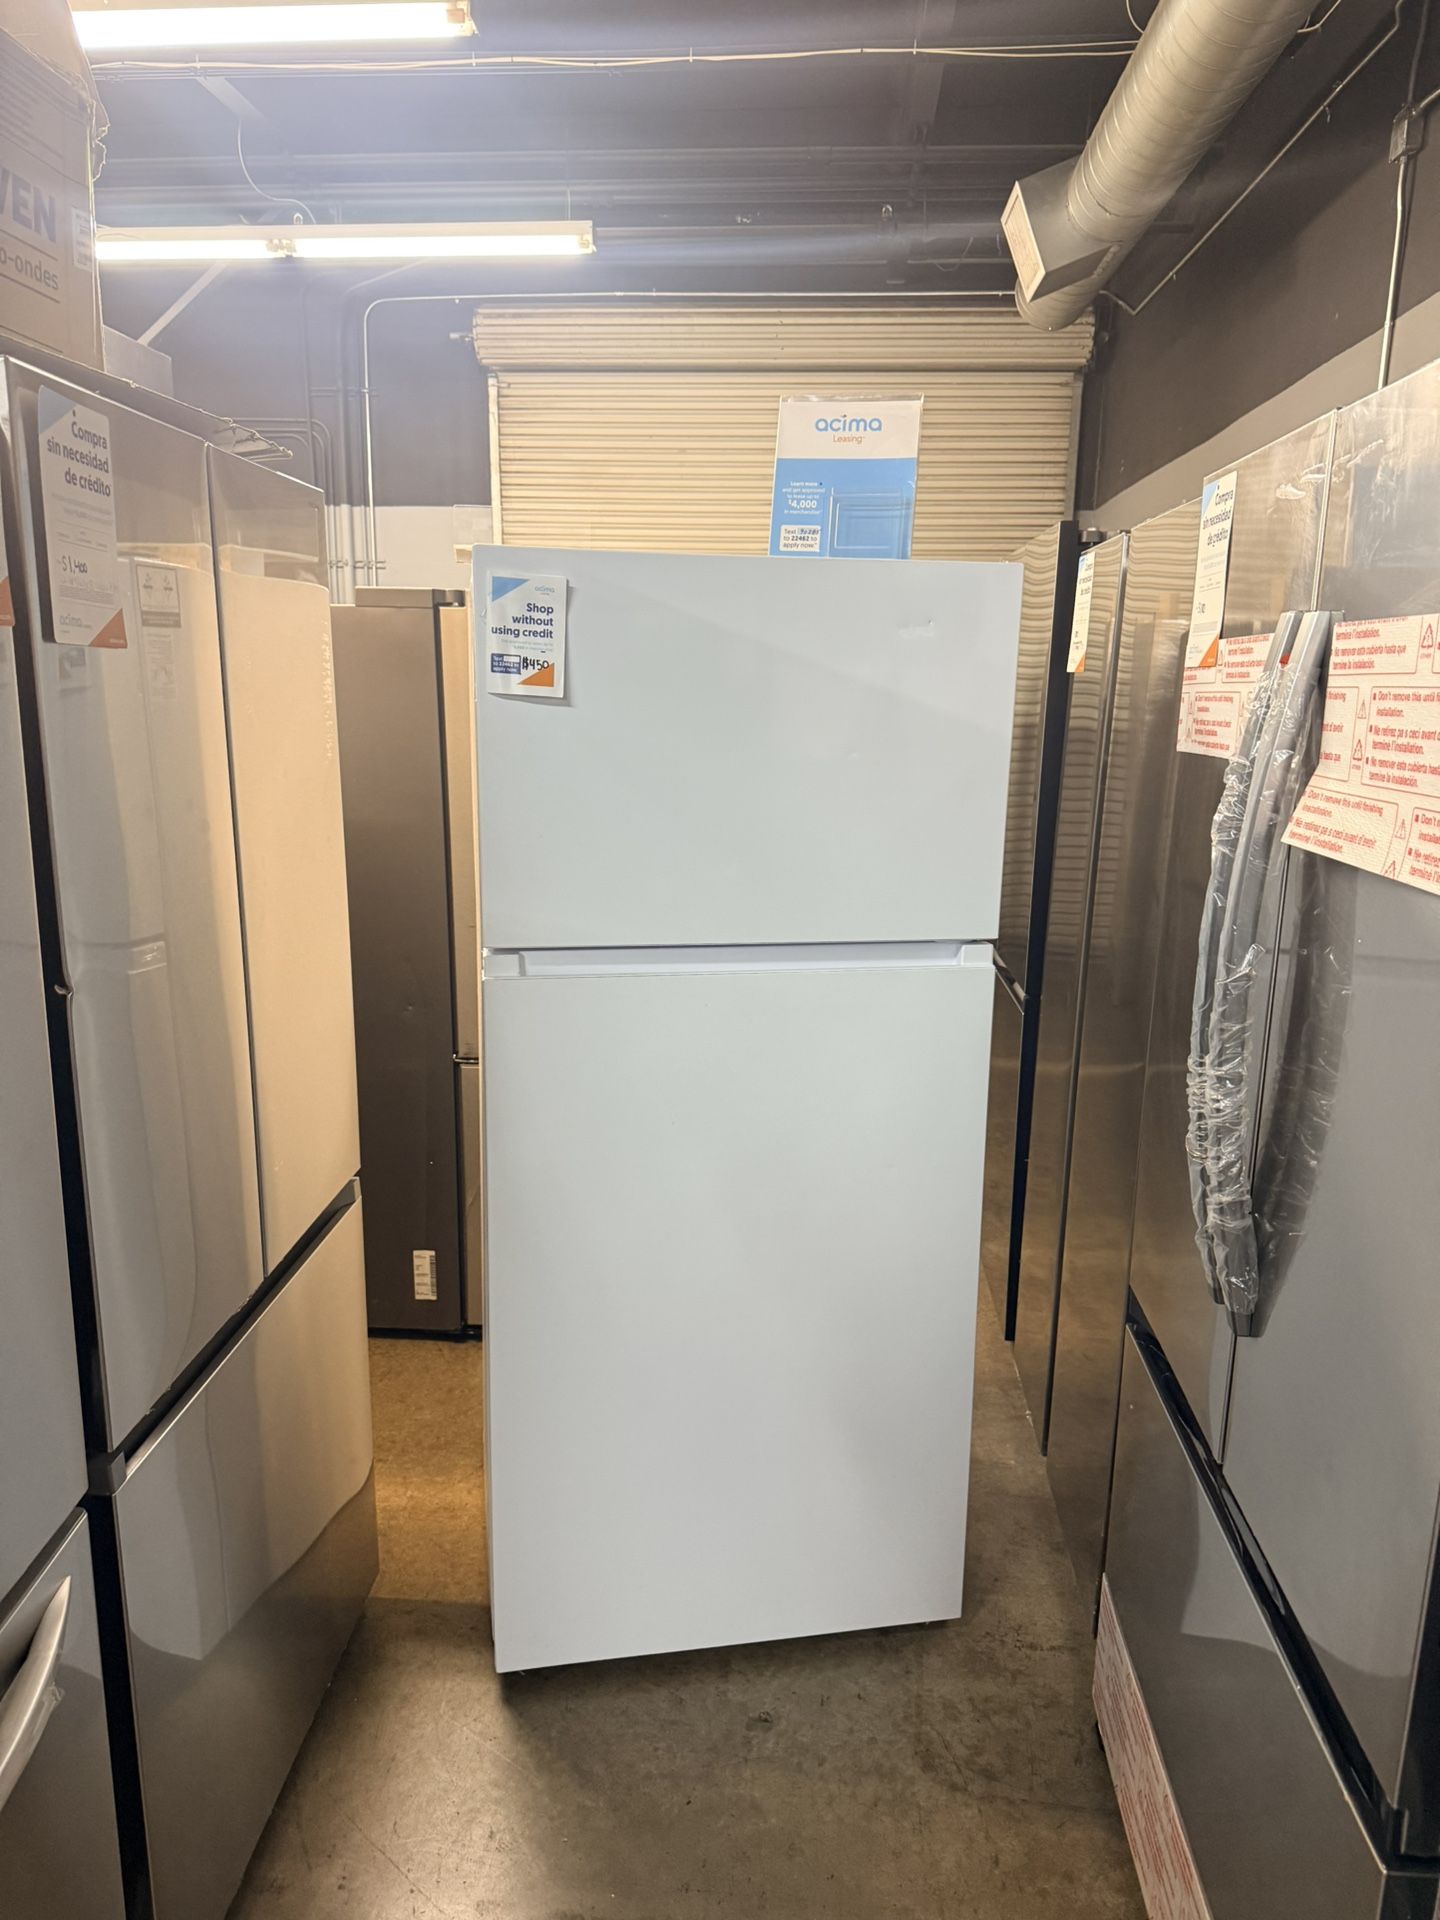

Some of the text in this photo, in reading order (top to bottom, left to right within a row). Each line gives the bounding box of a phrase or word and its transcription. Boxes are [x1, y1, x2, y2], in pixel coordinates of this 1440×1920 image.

[815, 414, 883, 432] acima
[71, 421, 108, 450] Compra
[832, 434, 864, 445] Leasing
[47, 436, 110, 474] sin necesidad
[64, 467, 78, 486] de
[788, 499, 817, 509] $4,000
[1215, 490, 1234, 506] Compra
[526, 602, 554, 616] Shop
[512, 614, 554, 627] without
[491, 625, 554, 639] using credit
[522, 656, 550, 671] $450
